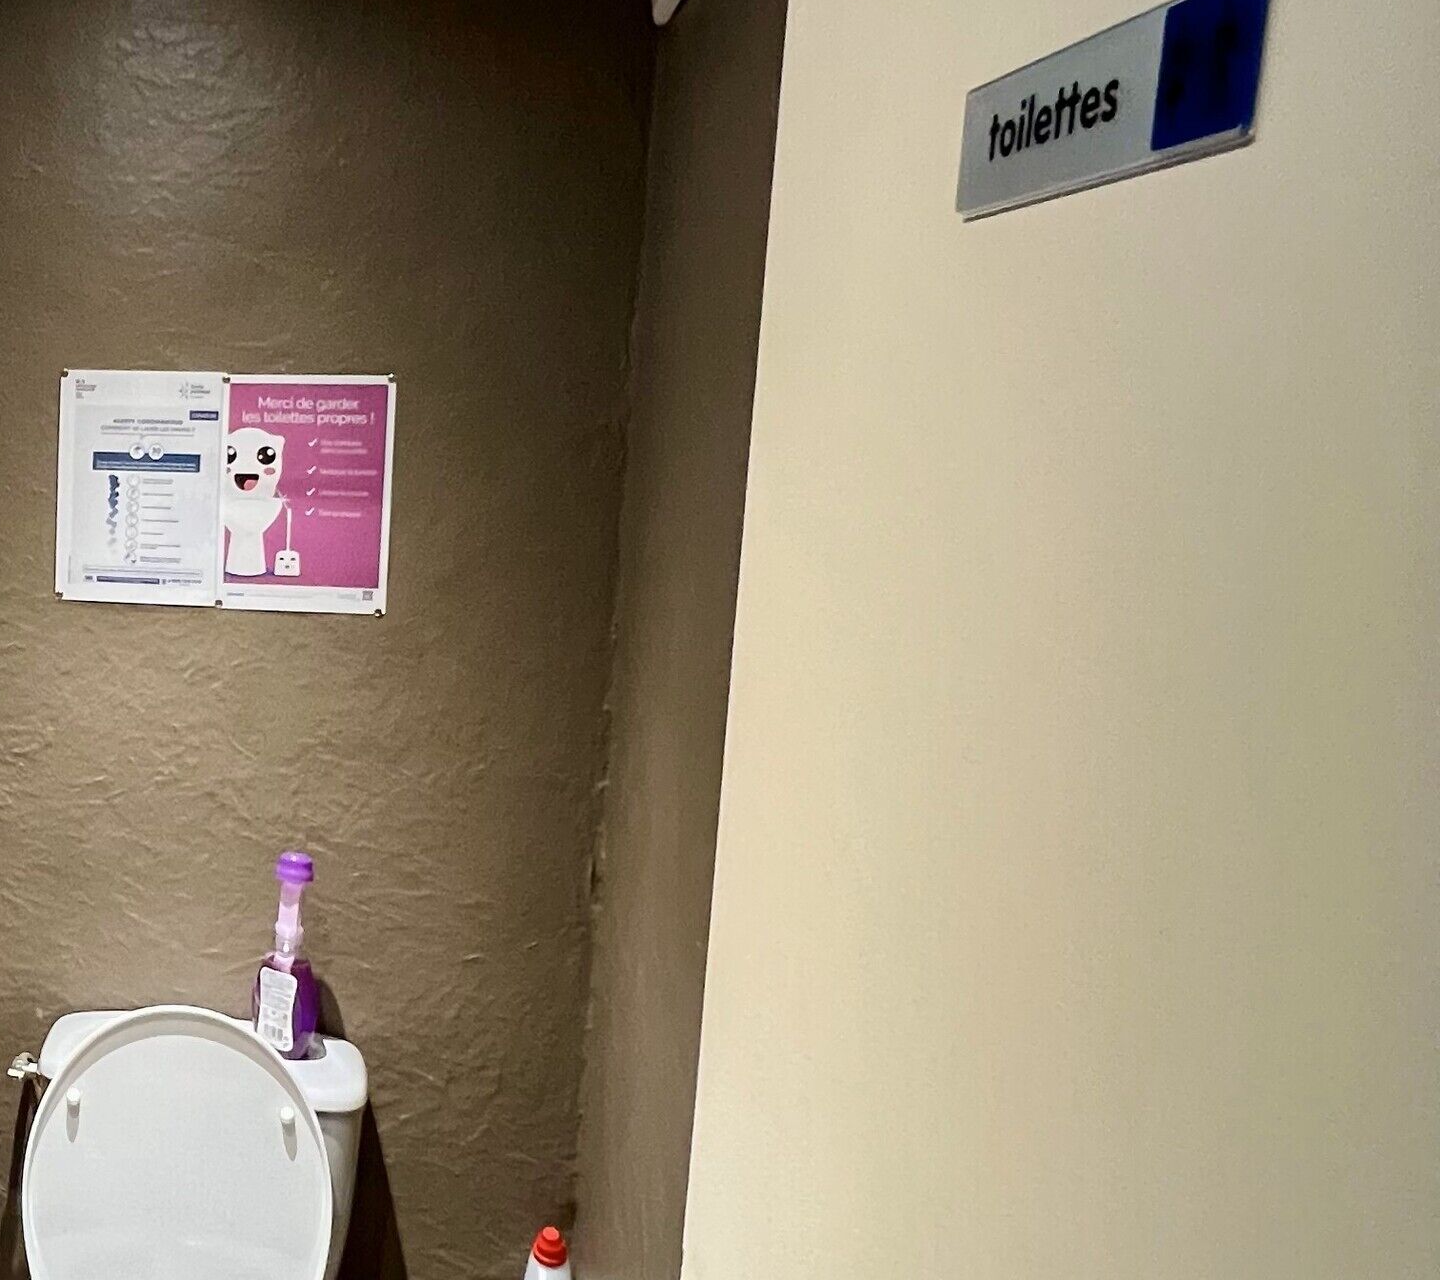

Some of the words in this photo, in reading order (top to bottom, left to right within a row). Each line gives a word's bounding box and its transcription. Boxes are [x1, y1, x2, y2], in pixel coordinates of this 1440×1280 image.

[988, 78, 1120, 162] toilettes
[258, 397, 294, 409] Merci
[296, 397, 314, 409] de
[316, 398, 360, 411] garder
[242, 410, 261, 423] les
[263, 411, 315, 424] toilettes
[317, 413, 368, 426] propres
